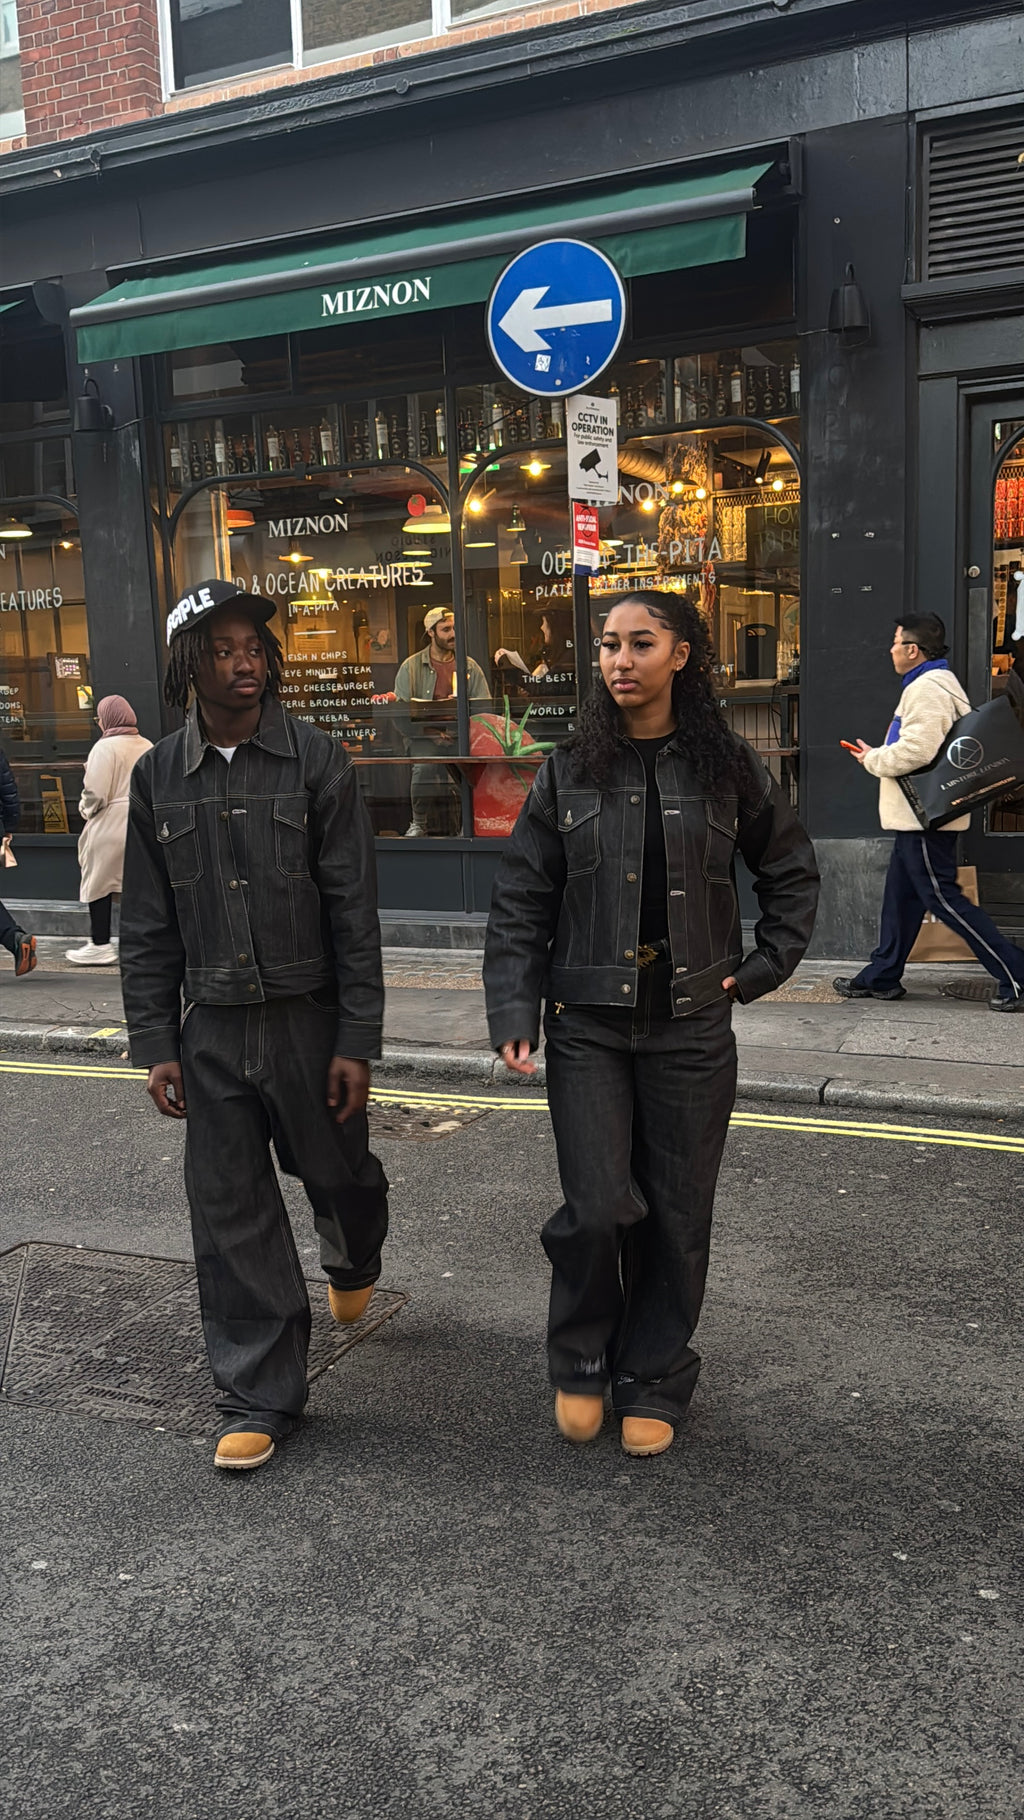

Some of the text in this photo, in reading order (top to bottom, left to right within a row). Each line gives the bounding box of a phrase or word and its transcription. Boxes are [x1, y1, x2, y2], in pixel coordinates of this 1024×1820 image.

[321, 277, 432, 317] MIZNON
[578, 412, 608, 425] CCTV IN
[572, 422, 614, 437] OPERATION
[268, 514, 349, 538] MIZNON
[252, 574, 262, 595] &
[266, 572, 320, 595] OCEAN
[324, 562, 424, 592] CREATURES
[288, 600, 340, 618] IN-A-PITA
[288, 651, 347, 662] FISH N CHIPS
[306, 667, 338, 677] MINUTE
[342, 666, 372, 675] STEAK
[522, 673, 573, 683] THE BEST
[304, 681, 375, 692] CHEESEBURGER
[310, 699, 347, 708] BROKEN
[351, 698, 389, 706] CHICKEN
[529, 706, 565, 716] WORLD
[320, 714, 350, 723] KEBAB
[346, 728, 377, 737] LIVERS
